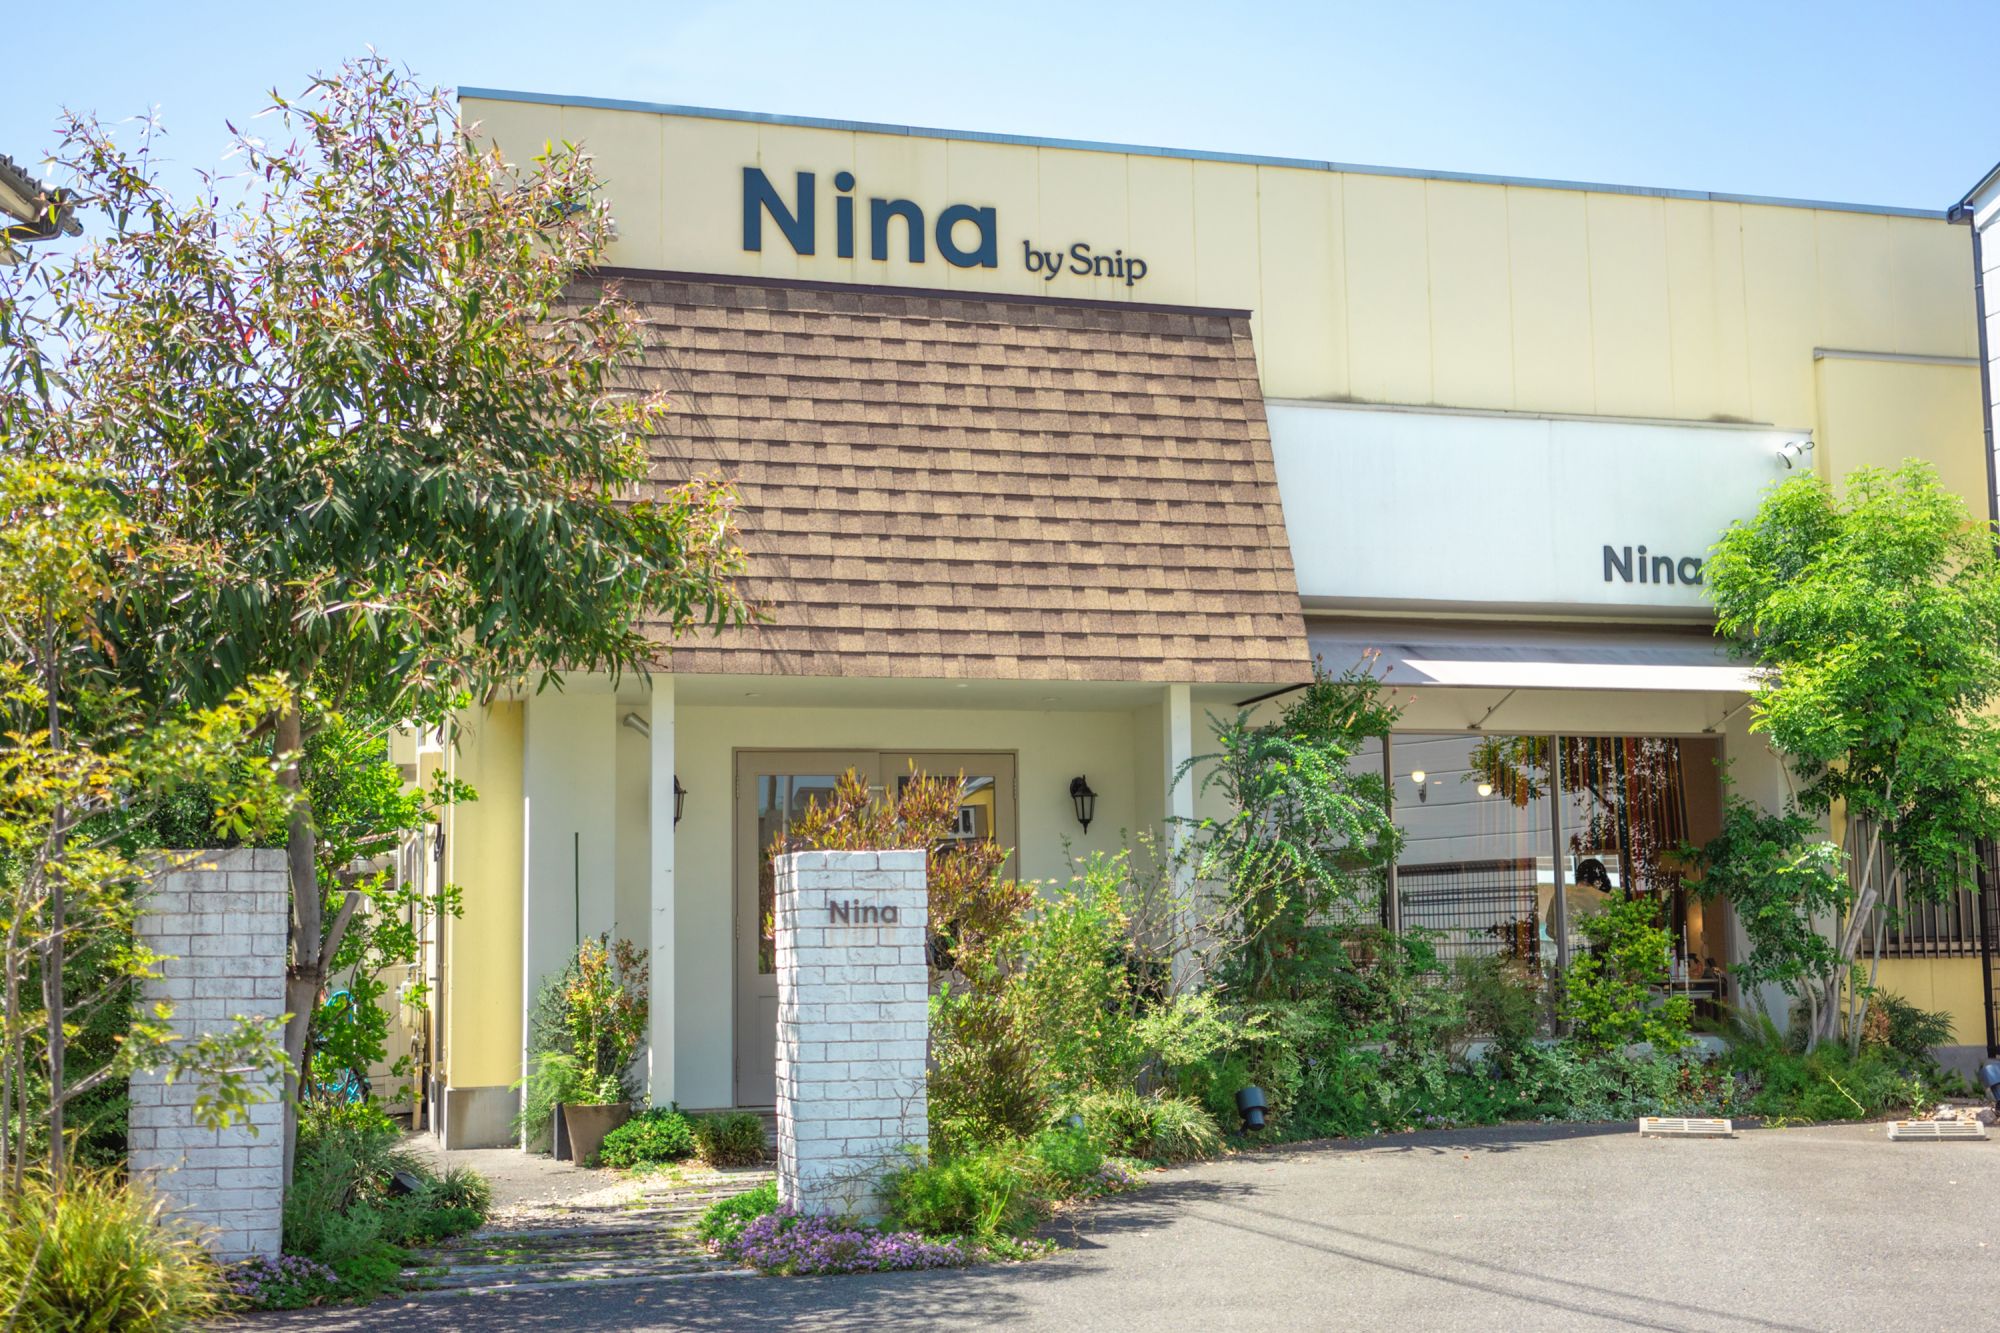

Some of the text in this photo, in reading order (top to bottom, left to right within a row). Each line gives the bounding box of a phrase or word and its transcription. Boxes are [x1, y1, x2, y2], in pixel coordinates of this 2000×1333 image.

[743, 167, 1147, 286] Nina by Snip
[1603, 545, 1703, 585] Nina
[830, 899, 898, 924] Nina
